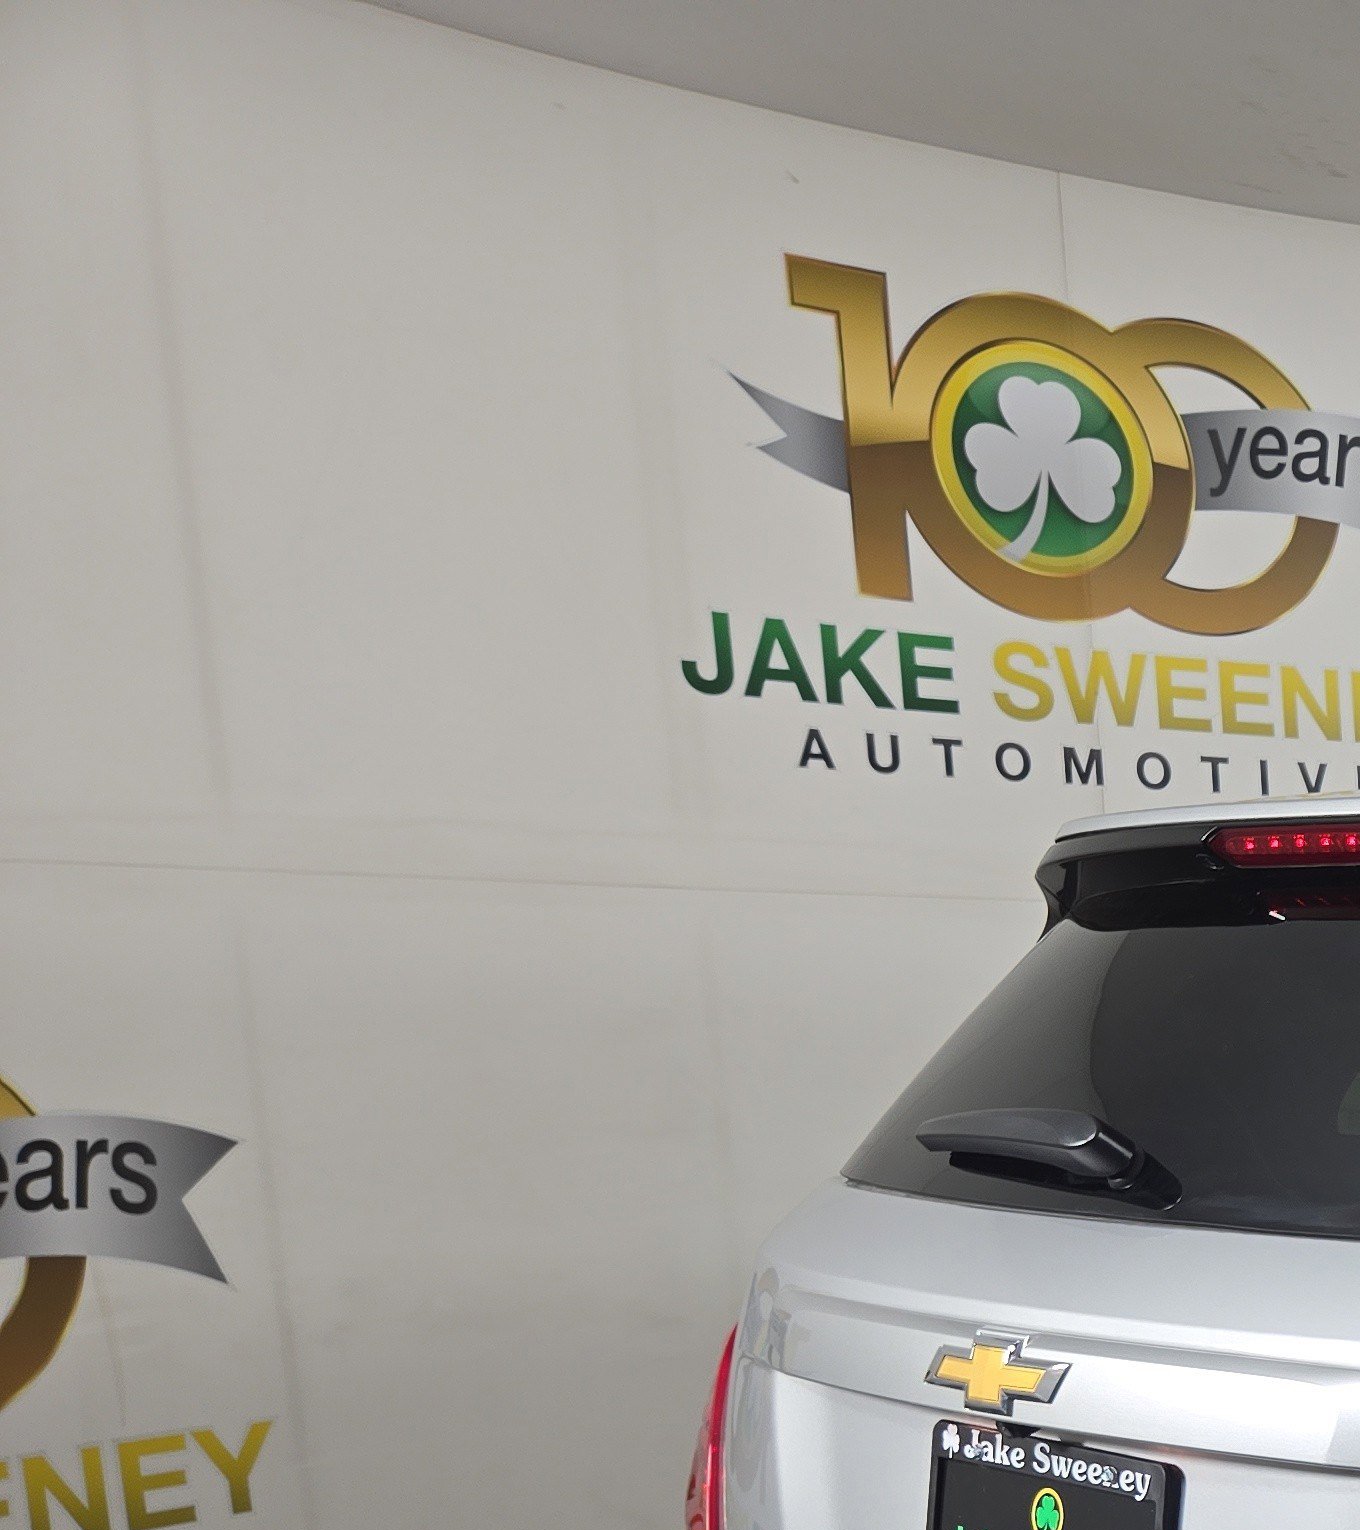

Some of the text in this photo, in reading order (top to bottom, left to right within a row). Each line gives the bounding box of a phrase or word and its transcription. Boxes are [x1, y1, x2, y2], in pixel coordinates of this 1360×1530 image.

[681, 611, 960, 715] JAKE
[0, 1138, 158, 1215] ars
[964, 1430, 1025, 1468] Jake
